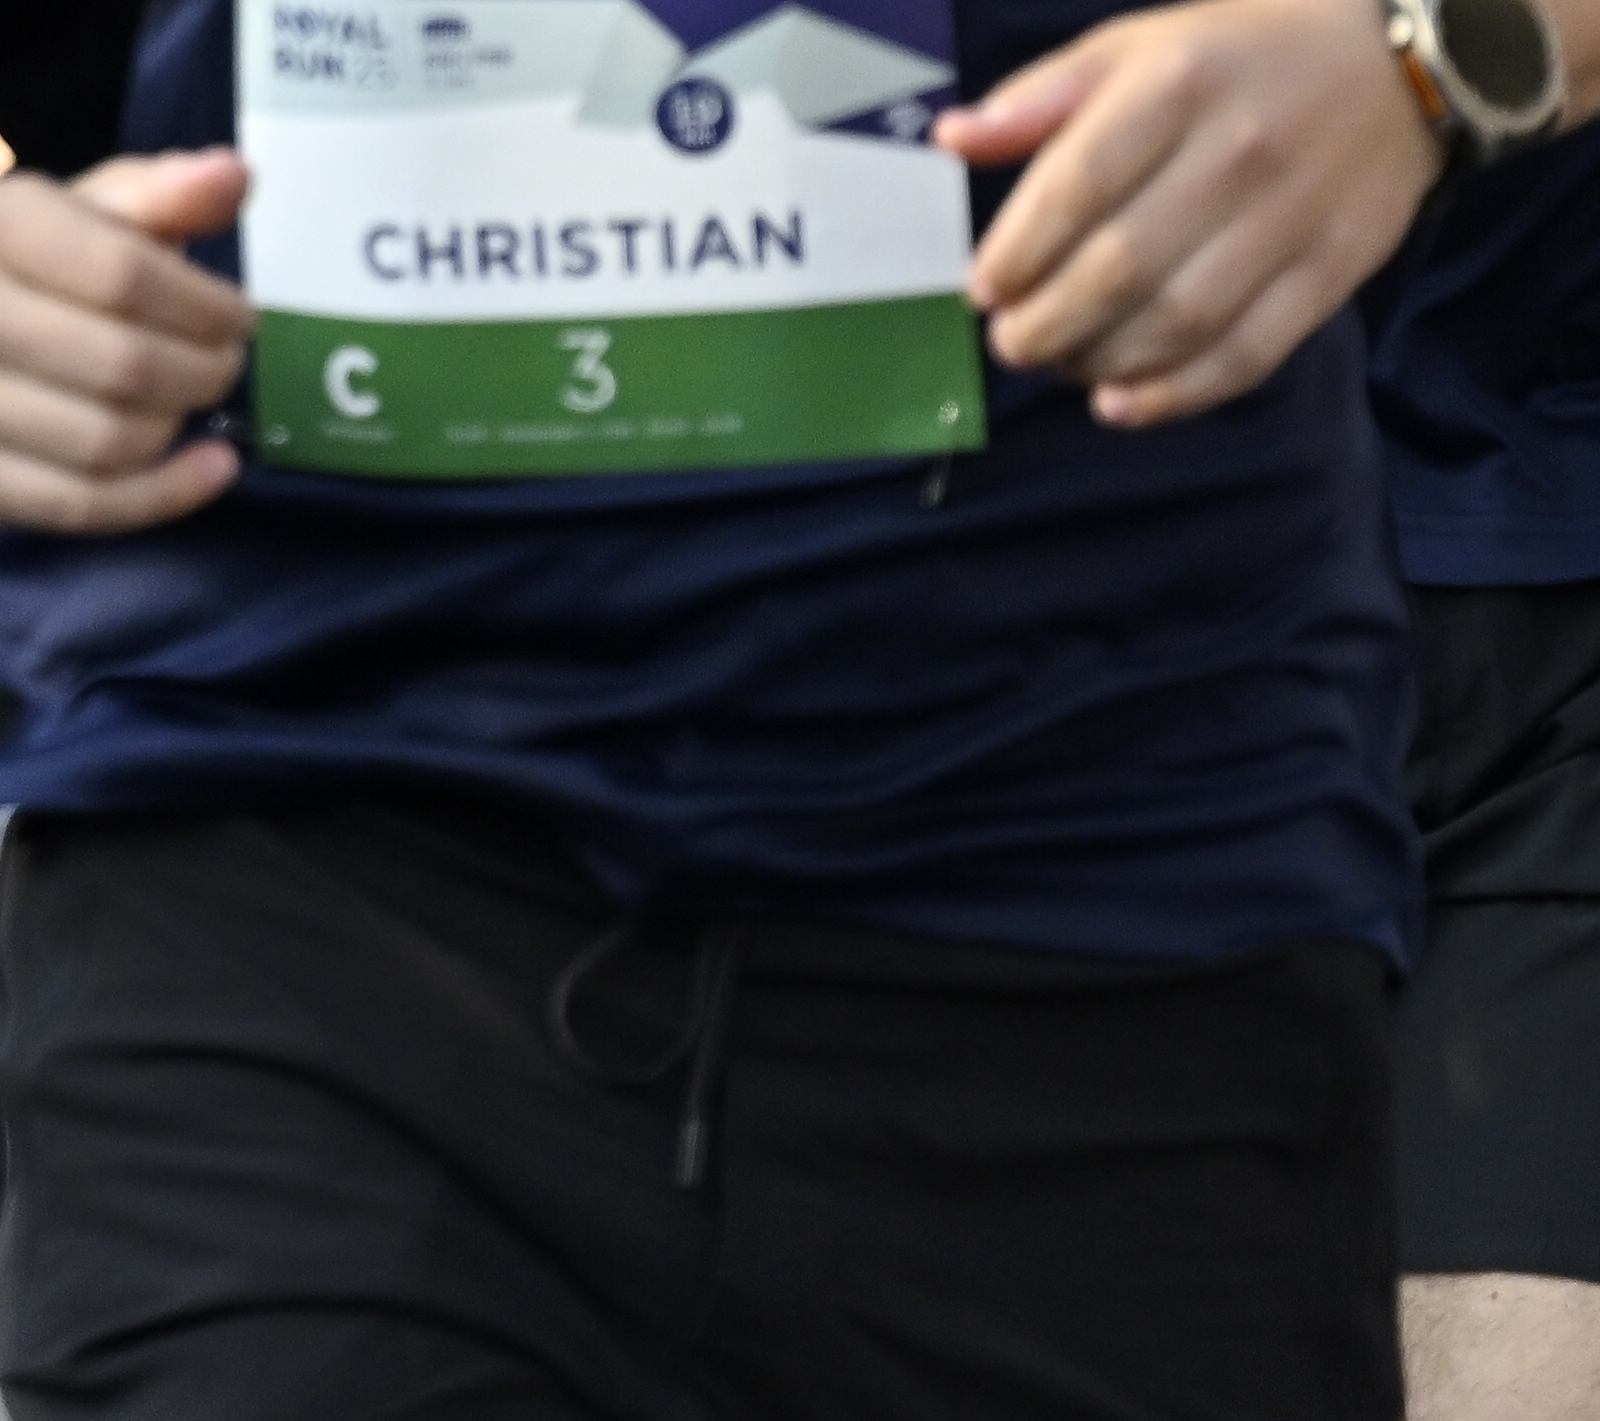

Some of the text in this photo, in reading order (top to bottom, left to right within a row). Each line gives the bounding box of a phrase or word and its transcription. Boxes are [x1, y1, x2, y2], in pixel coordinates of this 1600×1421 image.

[360, 208, 808, 284] CHRISTIAN
[321, 344, 381, 419] C
[555, 330, 618, 414] 3
